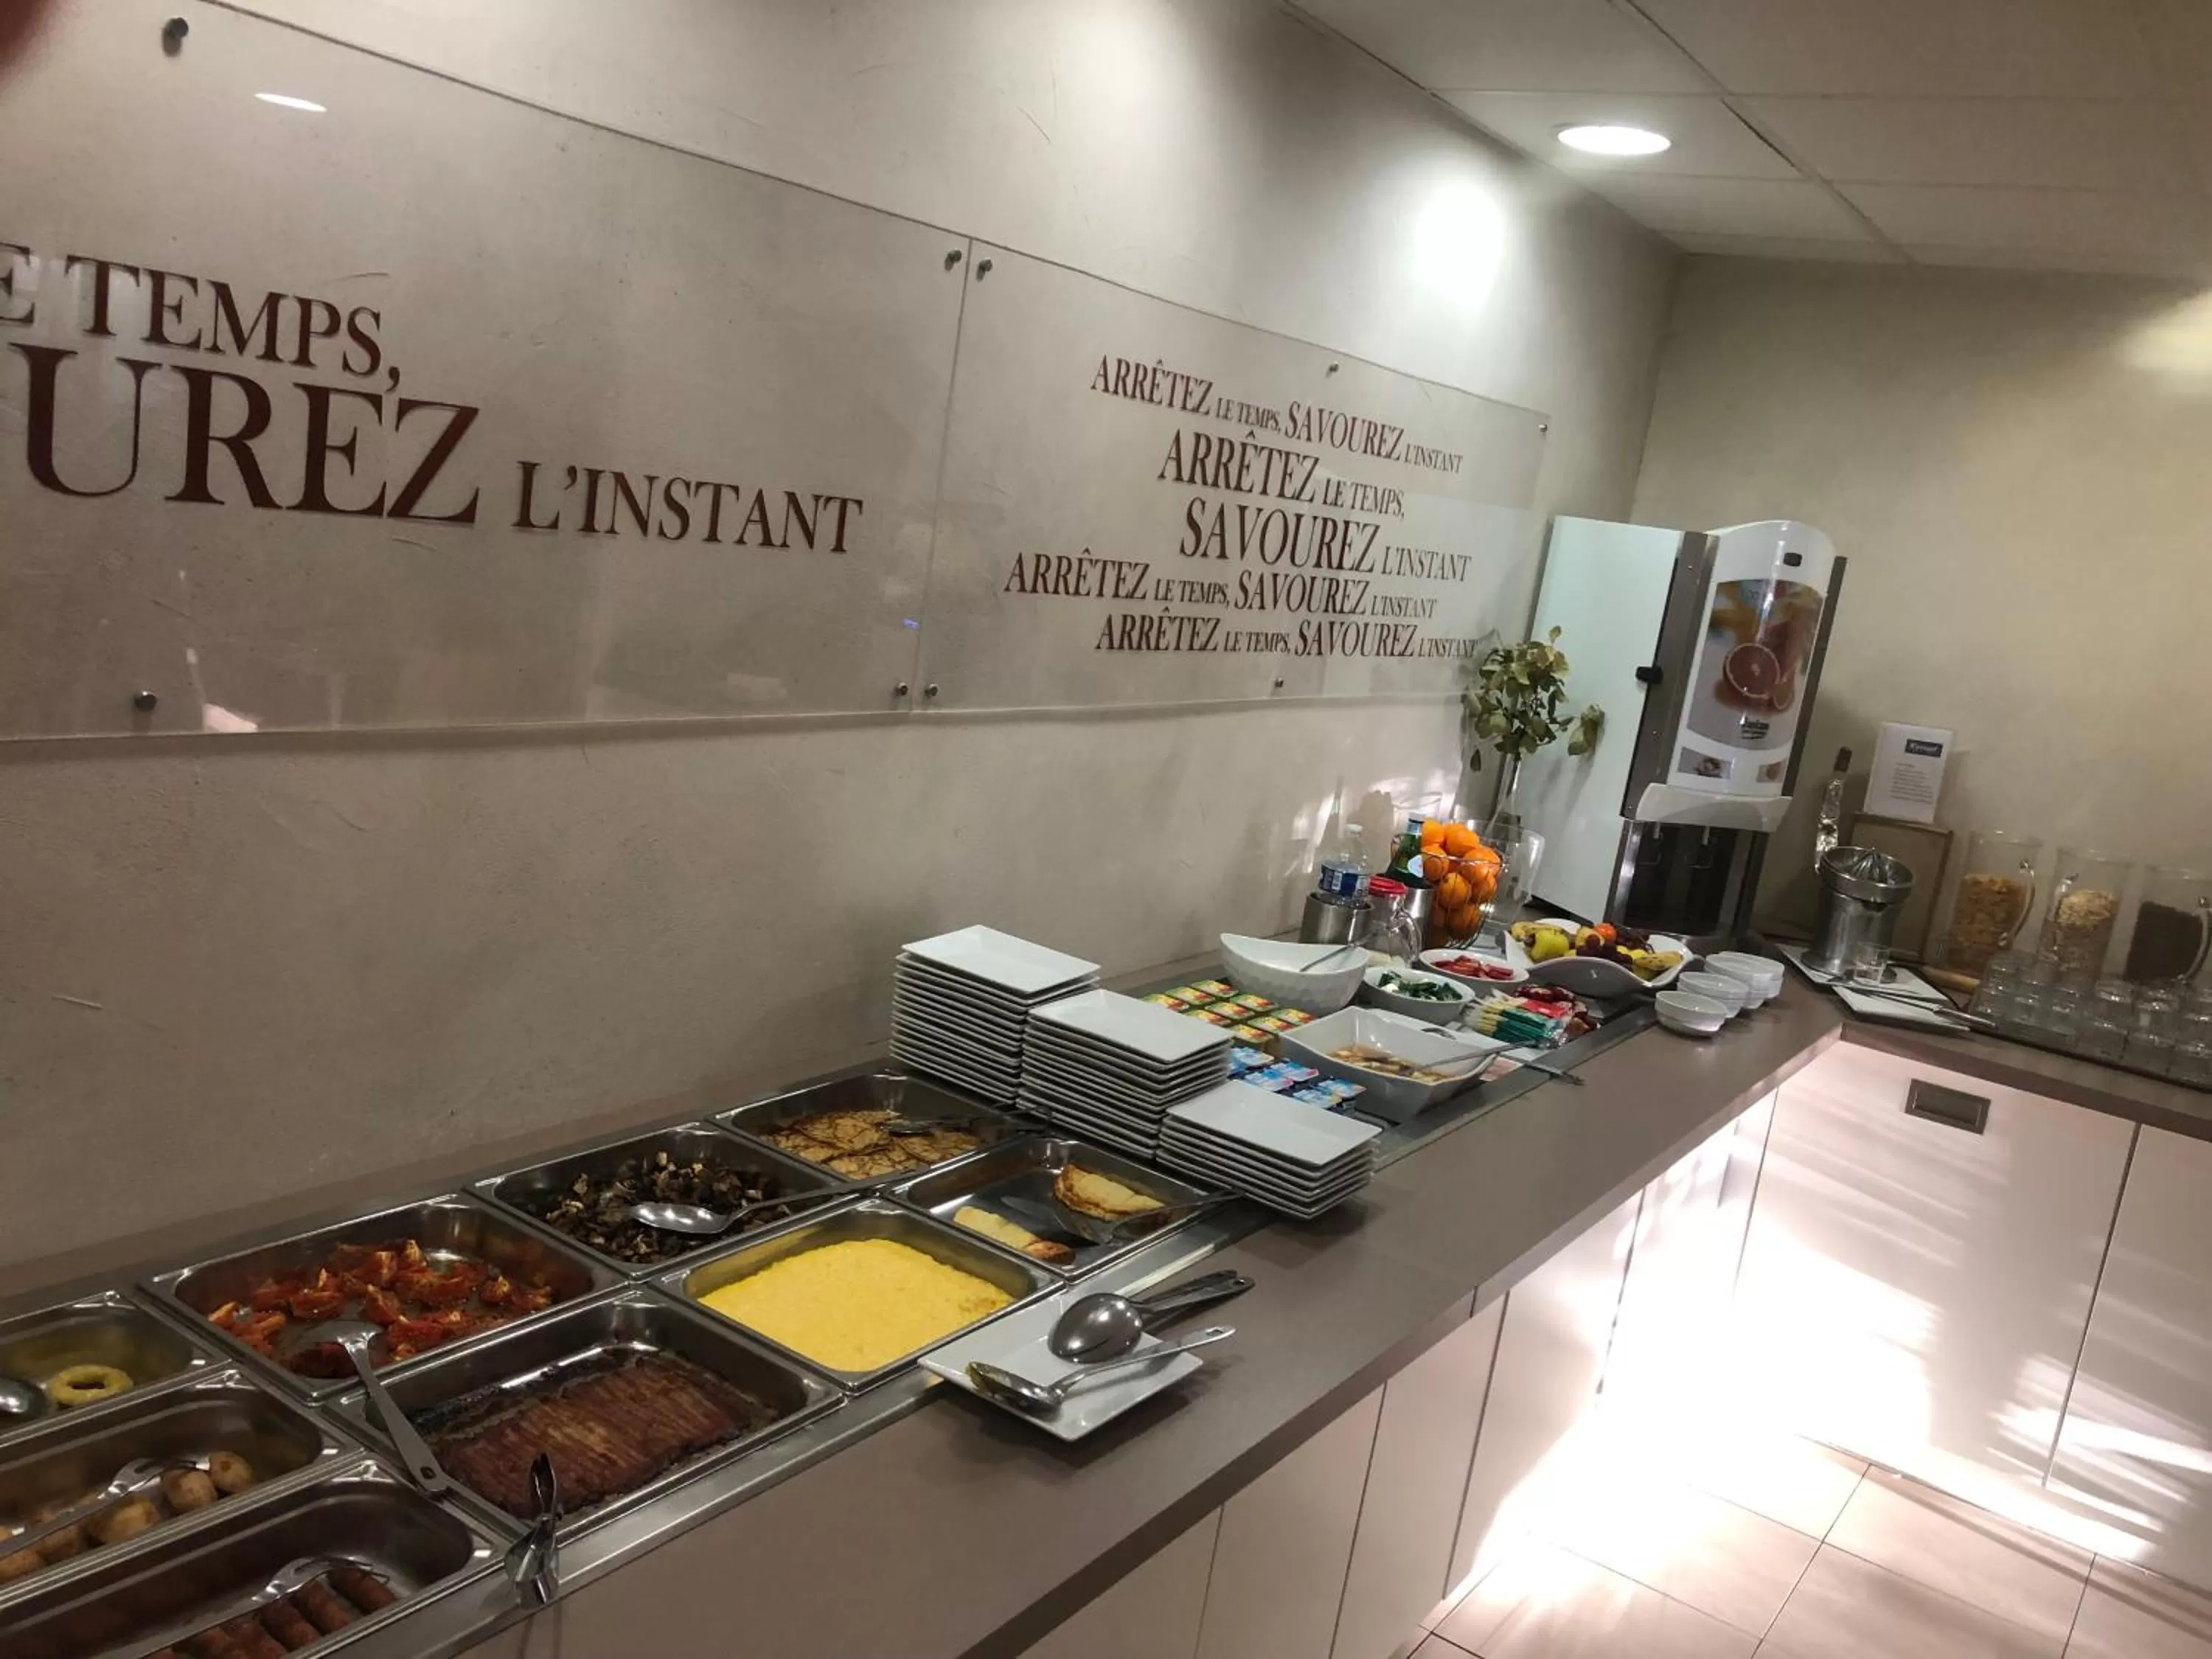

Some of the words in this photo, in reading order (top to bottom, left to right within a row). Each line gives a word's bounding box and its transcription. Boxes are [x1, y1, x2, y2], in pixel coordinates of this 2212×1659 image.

[65, 255, 400, 392] TEMPS,
[8, 342, 480, 524] UREZ
[512, 460, 863, 553] L'INSTANT
[1090, 353, 1214, 416] ARRÊTEZ
[1215, 397, 1234, 422] LE
[1284, 400, 1405, 461] SAVOUREZ
[1404, 442, 1464, 474] L'INSTANT
[1157, 428, 1320, 503] ARRÊTEZ
[1321, 477, 1347, 507] LE
[1349, 481, 1405, 519] TEMPS,
[1004, 547, 1150, 599] ARRÊTEZ
[1153, 577, 1175, 601] LE
[1179, 580, 1230, 608] TEMPS,
[1234, 569, 1370, 614] SAVOUREZ
[1370, 594, 1437, 618] L'INSTANT
[1180, 496, 1380, 573] SAVOUREZ
[1381, 546, 1472, 582] L'INSTANT
[1094, 605, 1220, 651] ARRÊTEZ
[1223, 630, 1241, 652] LE
[1295, 619, 1419, 657] SAVOUREZ
